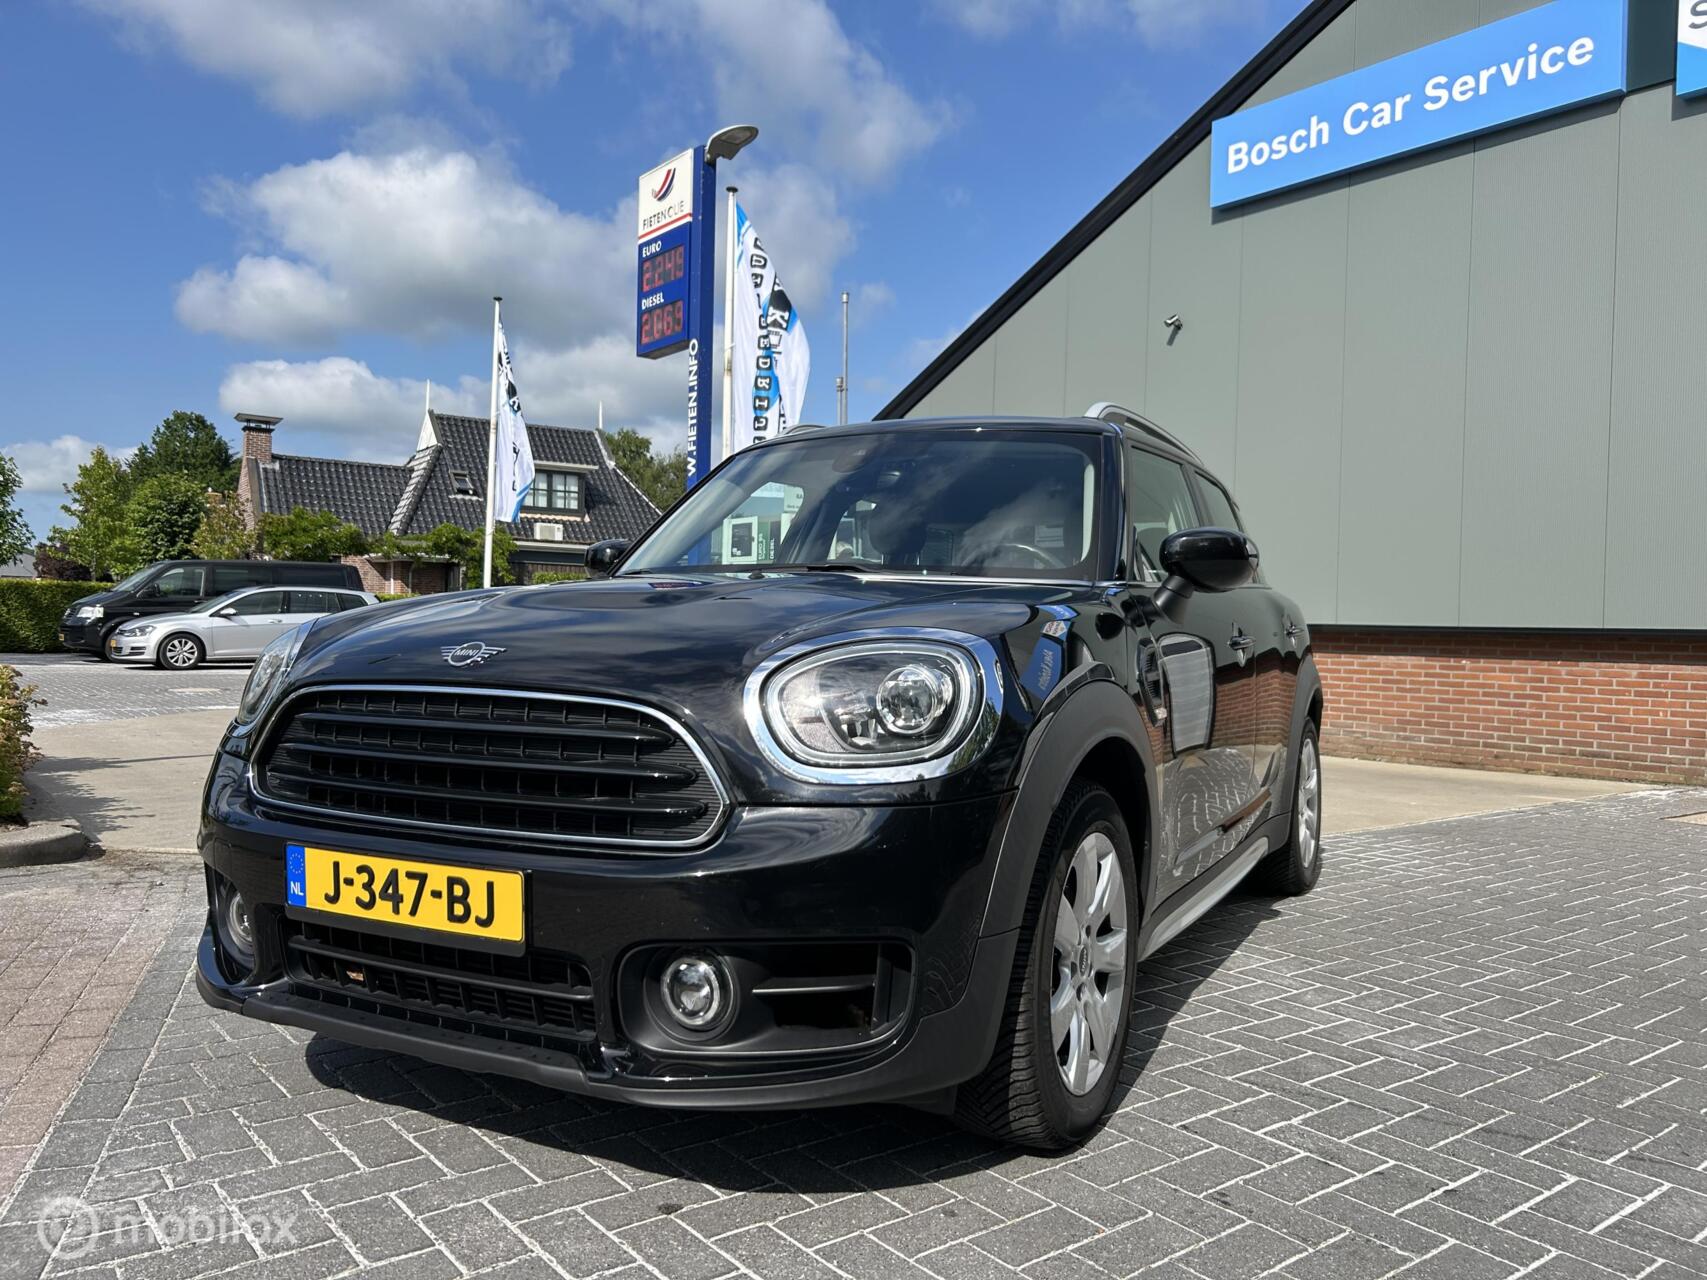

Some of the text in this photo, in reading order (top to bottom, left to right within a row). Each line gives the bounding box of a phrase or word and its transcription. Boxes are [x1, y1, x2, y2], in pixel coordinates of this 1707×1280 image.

[1226, 37, 1595, 174] Bosch Car Service
[642, 240, 662, 258] EURO
[641, 291, 665, 310] DIESEL
[687, 338, 698, 477] W.FIETEN.INFO
[454, 648, 480, 656] MINI
[290, 881, 304, 896] NL
[324, 860, 496, 928] J-347-BJ
